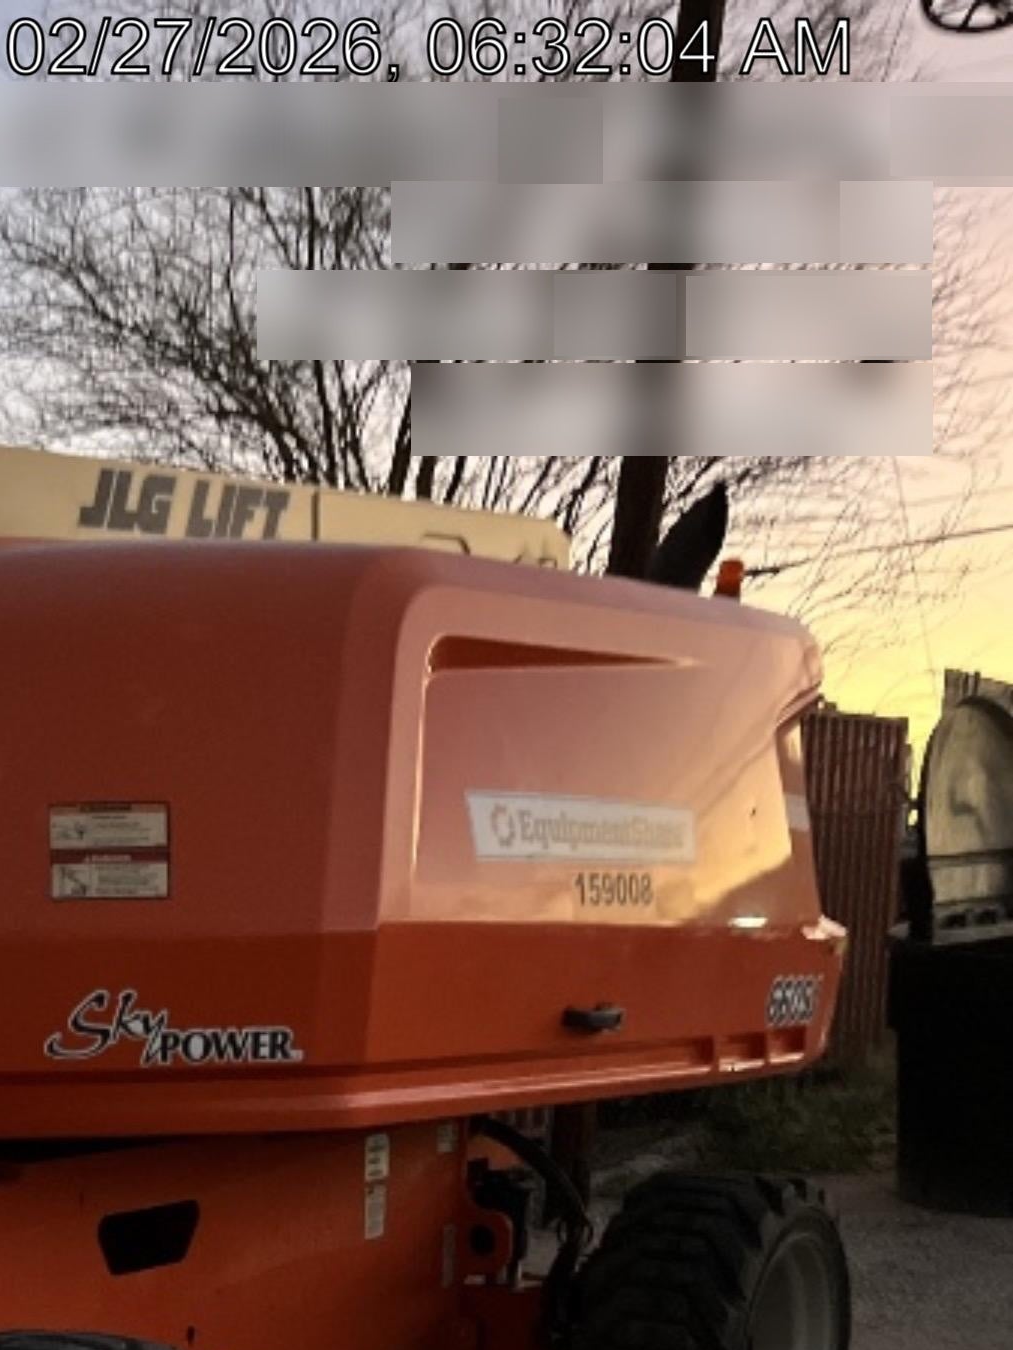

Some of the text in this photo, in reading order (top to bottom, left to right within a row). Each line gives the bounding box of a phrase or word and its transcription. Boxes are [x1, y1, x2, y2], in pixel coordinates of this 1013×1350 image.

[78, 469, 291, 540] JLG LIFT
[574, 873, 654, 907] 159008
[44, 988, 169, 1067] Sky
[156, 1027, 304, 1065] POWER
